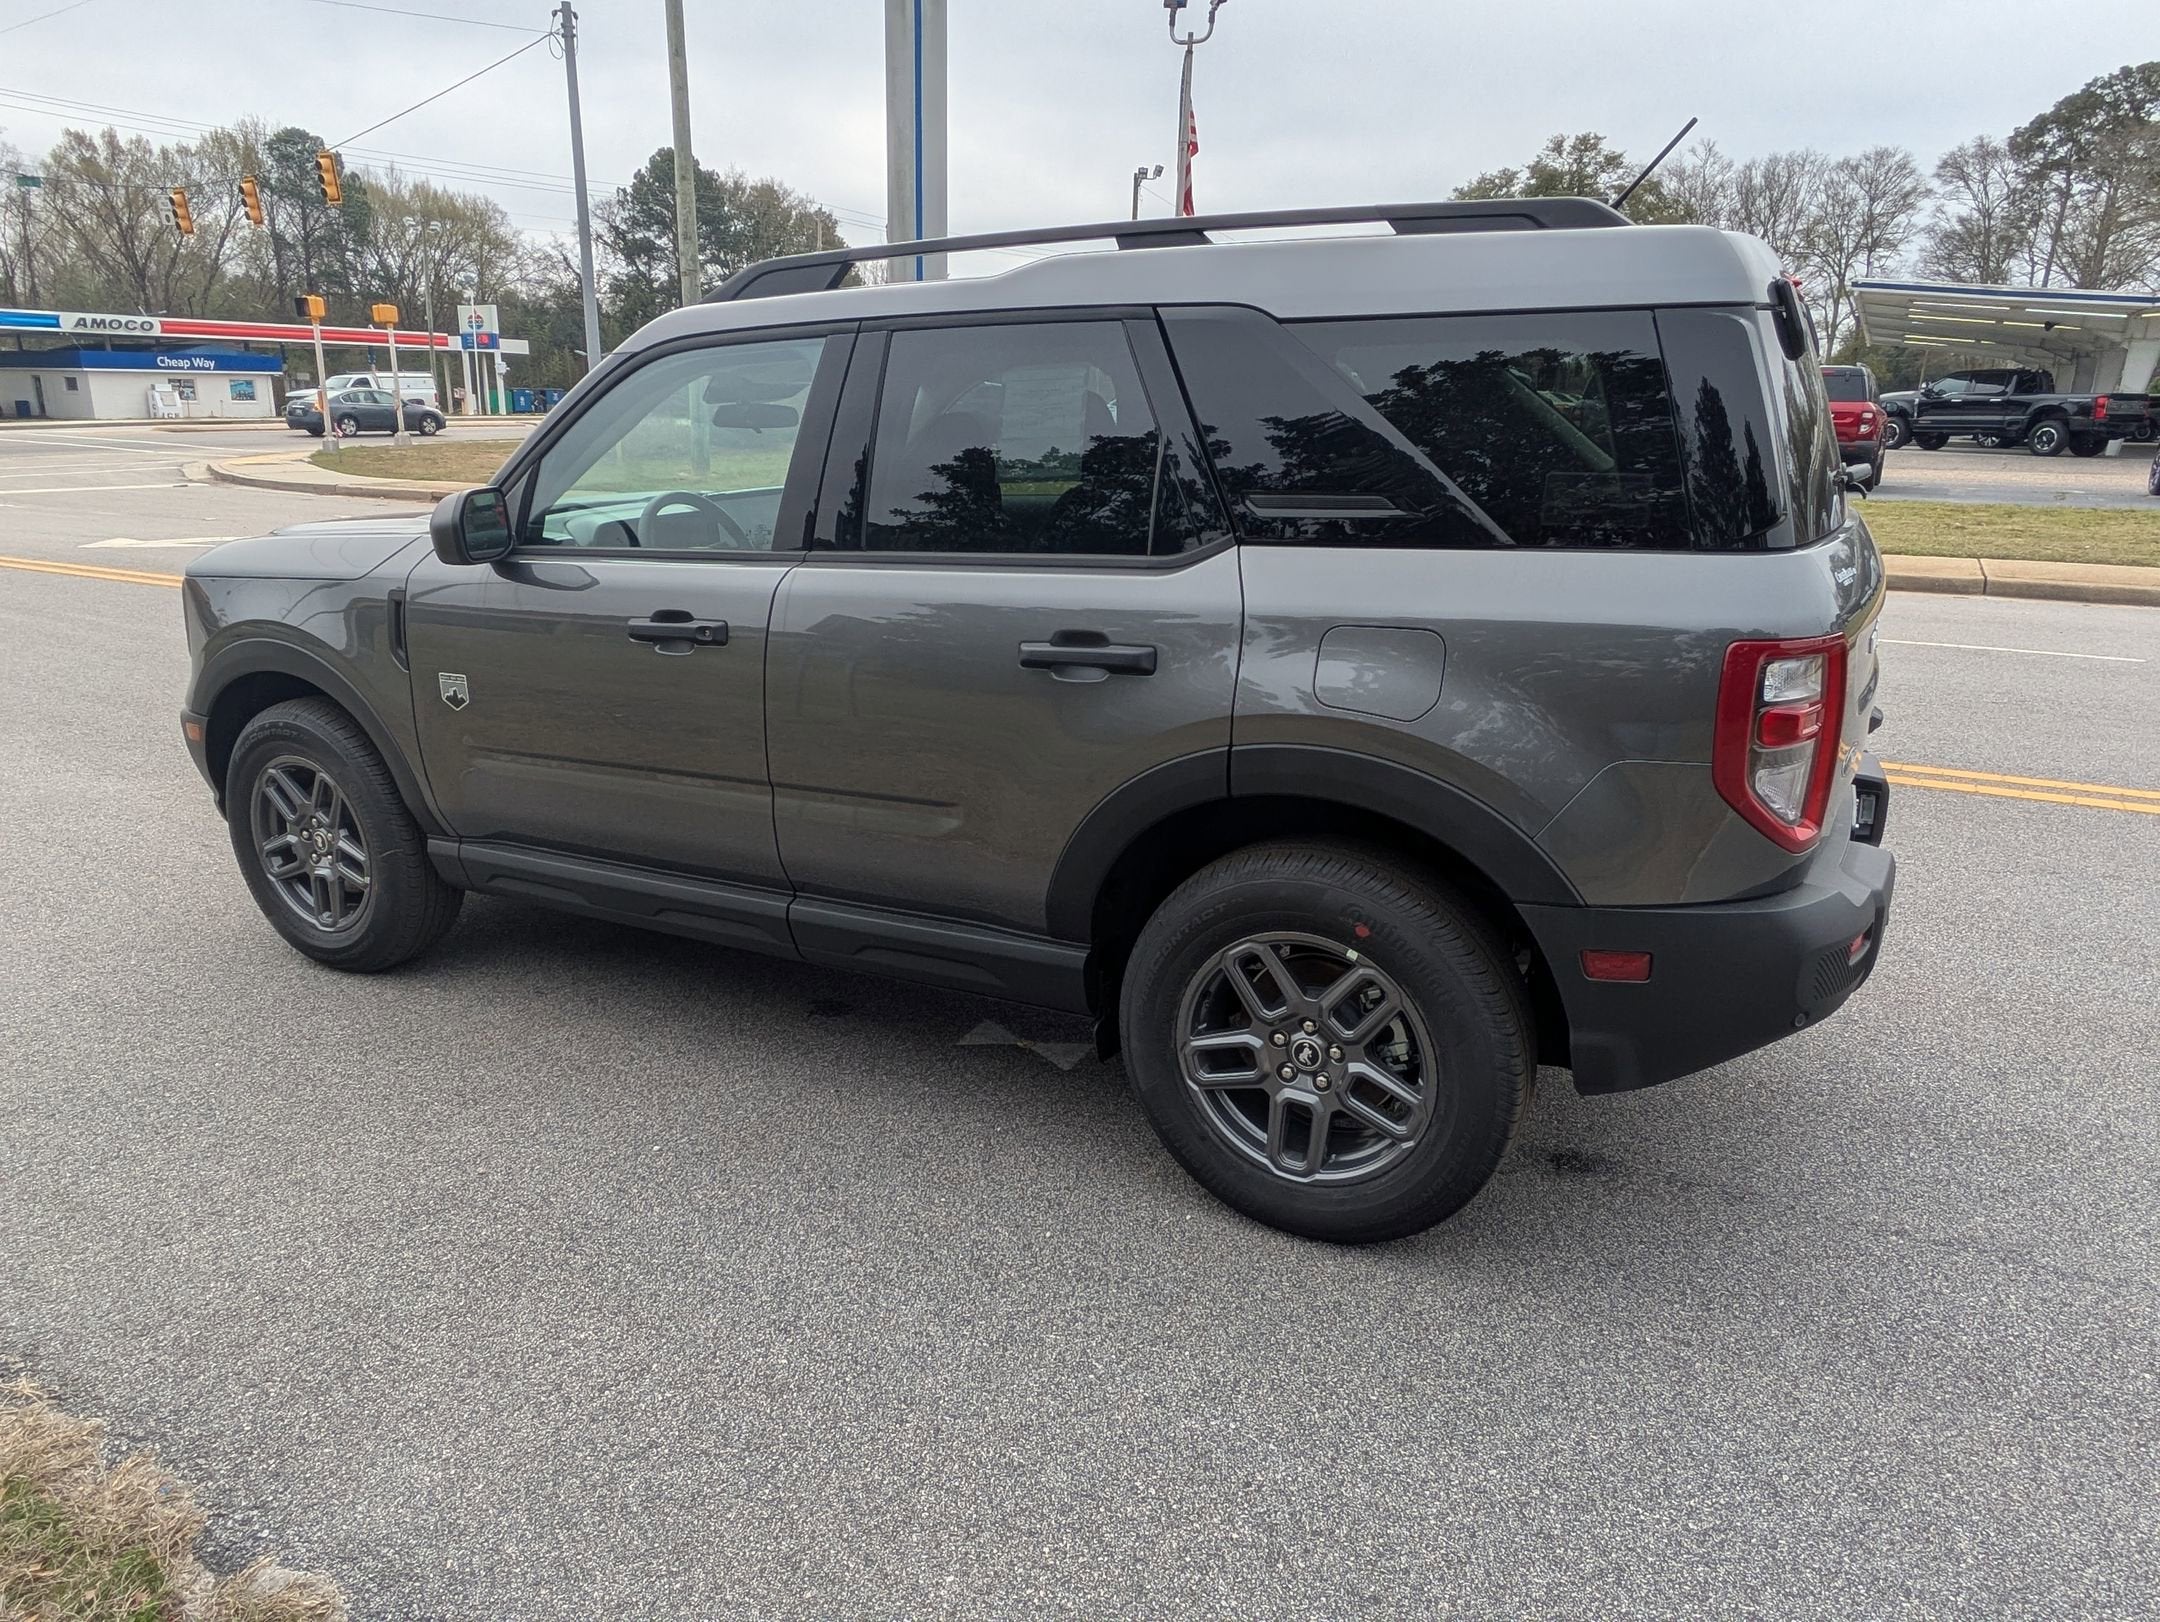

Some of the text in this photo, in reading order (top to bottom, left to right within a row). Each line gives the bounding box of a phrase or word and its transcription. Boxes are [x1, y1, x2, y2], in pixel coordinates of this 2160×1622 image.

[74, 317, 154, 331] AMOCO
[157, 356, 215, 371] Cheap Way
